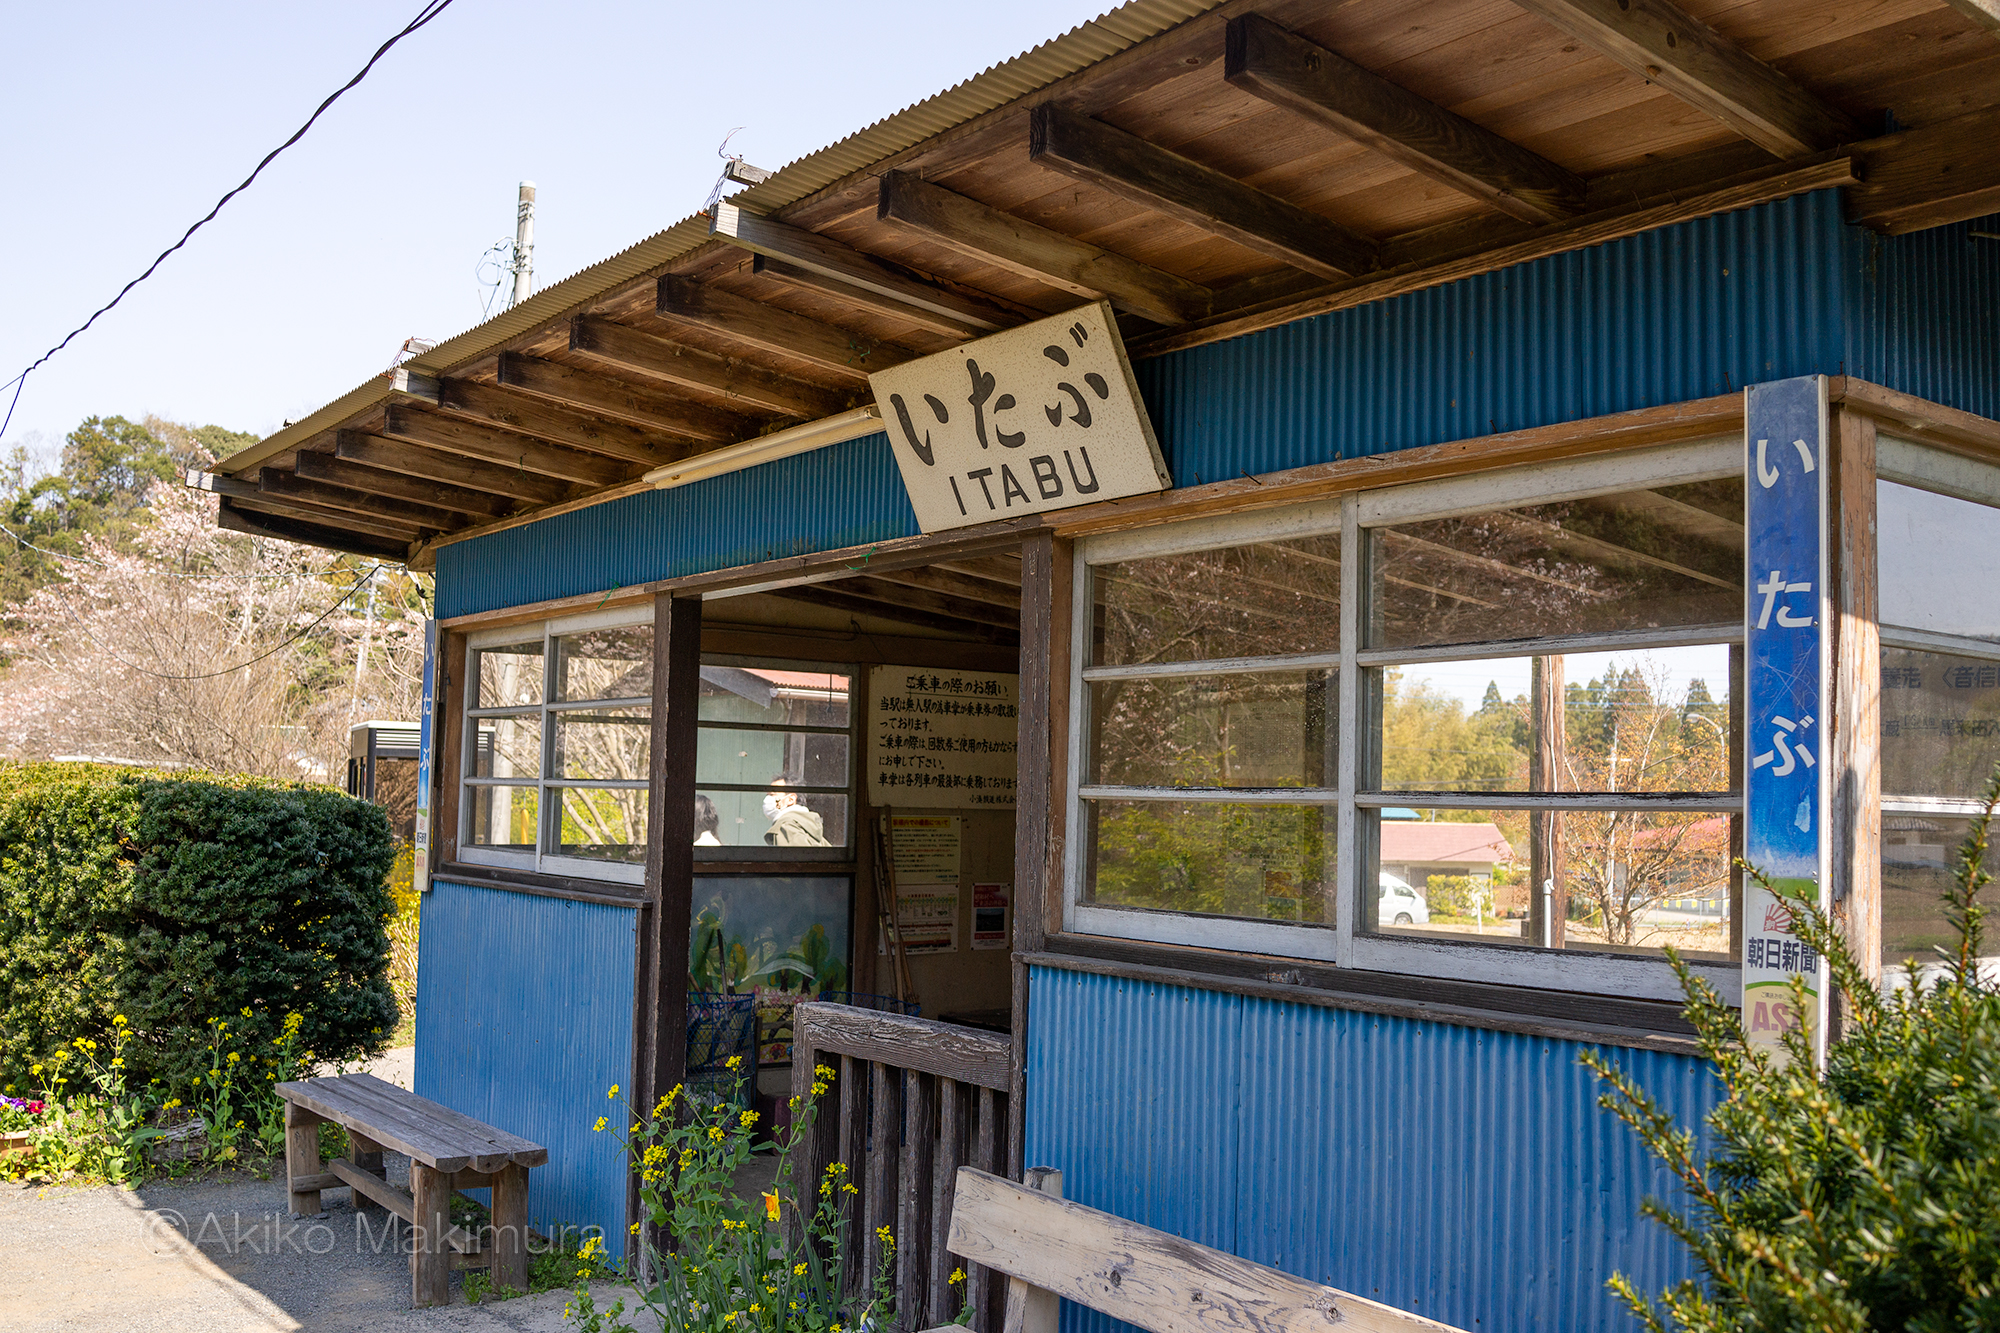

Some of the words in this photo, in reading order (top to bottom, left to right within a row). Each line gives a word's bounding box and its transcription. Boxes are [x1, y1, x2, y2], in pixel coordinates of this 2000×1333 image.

[890, 321, 1109, 467] いたぶ
[948, 446, 1100, 516] ITABU
[1752, 438, 1816, 777] いたぶ
[880, 716, 932, 732] っております。
[1747, 937, 1817, 974] 朝日新聞
